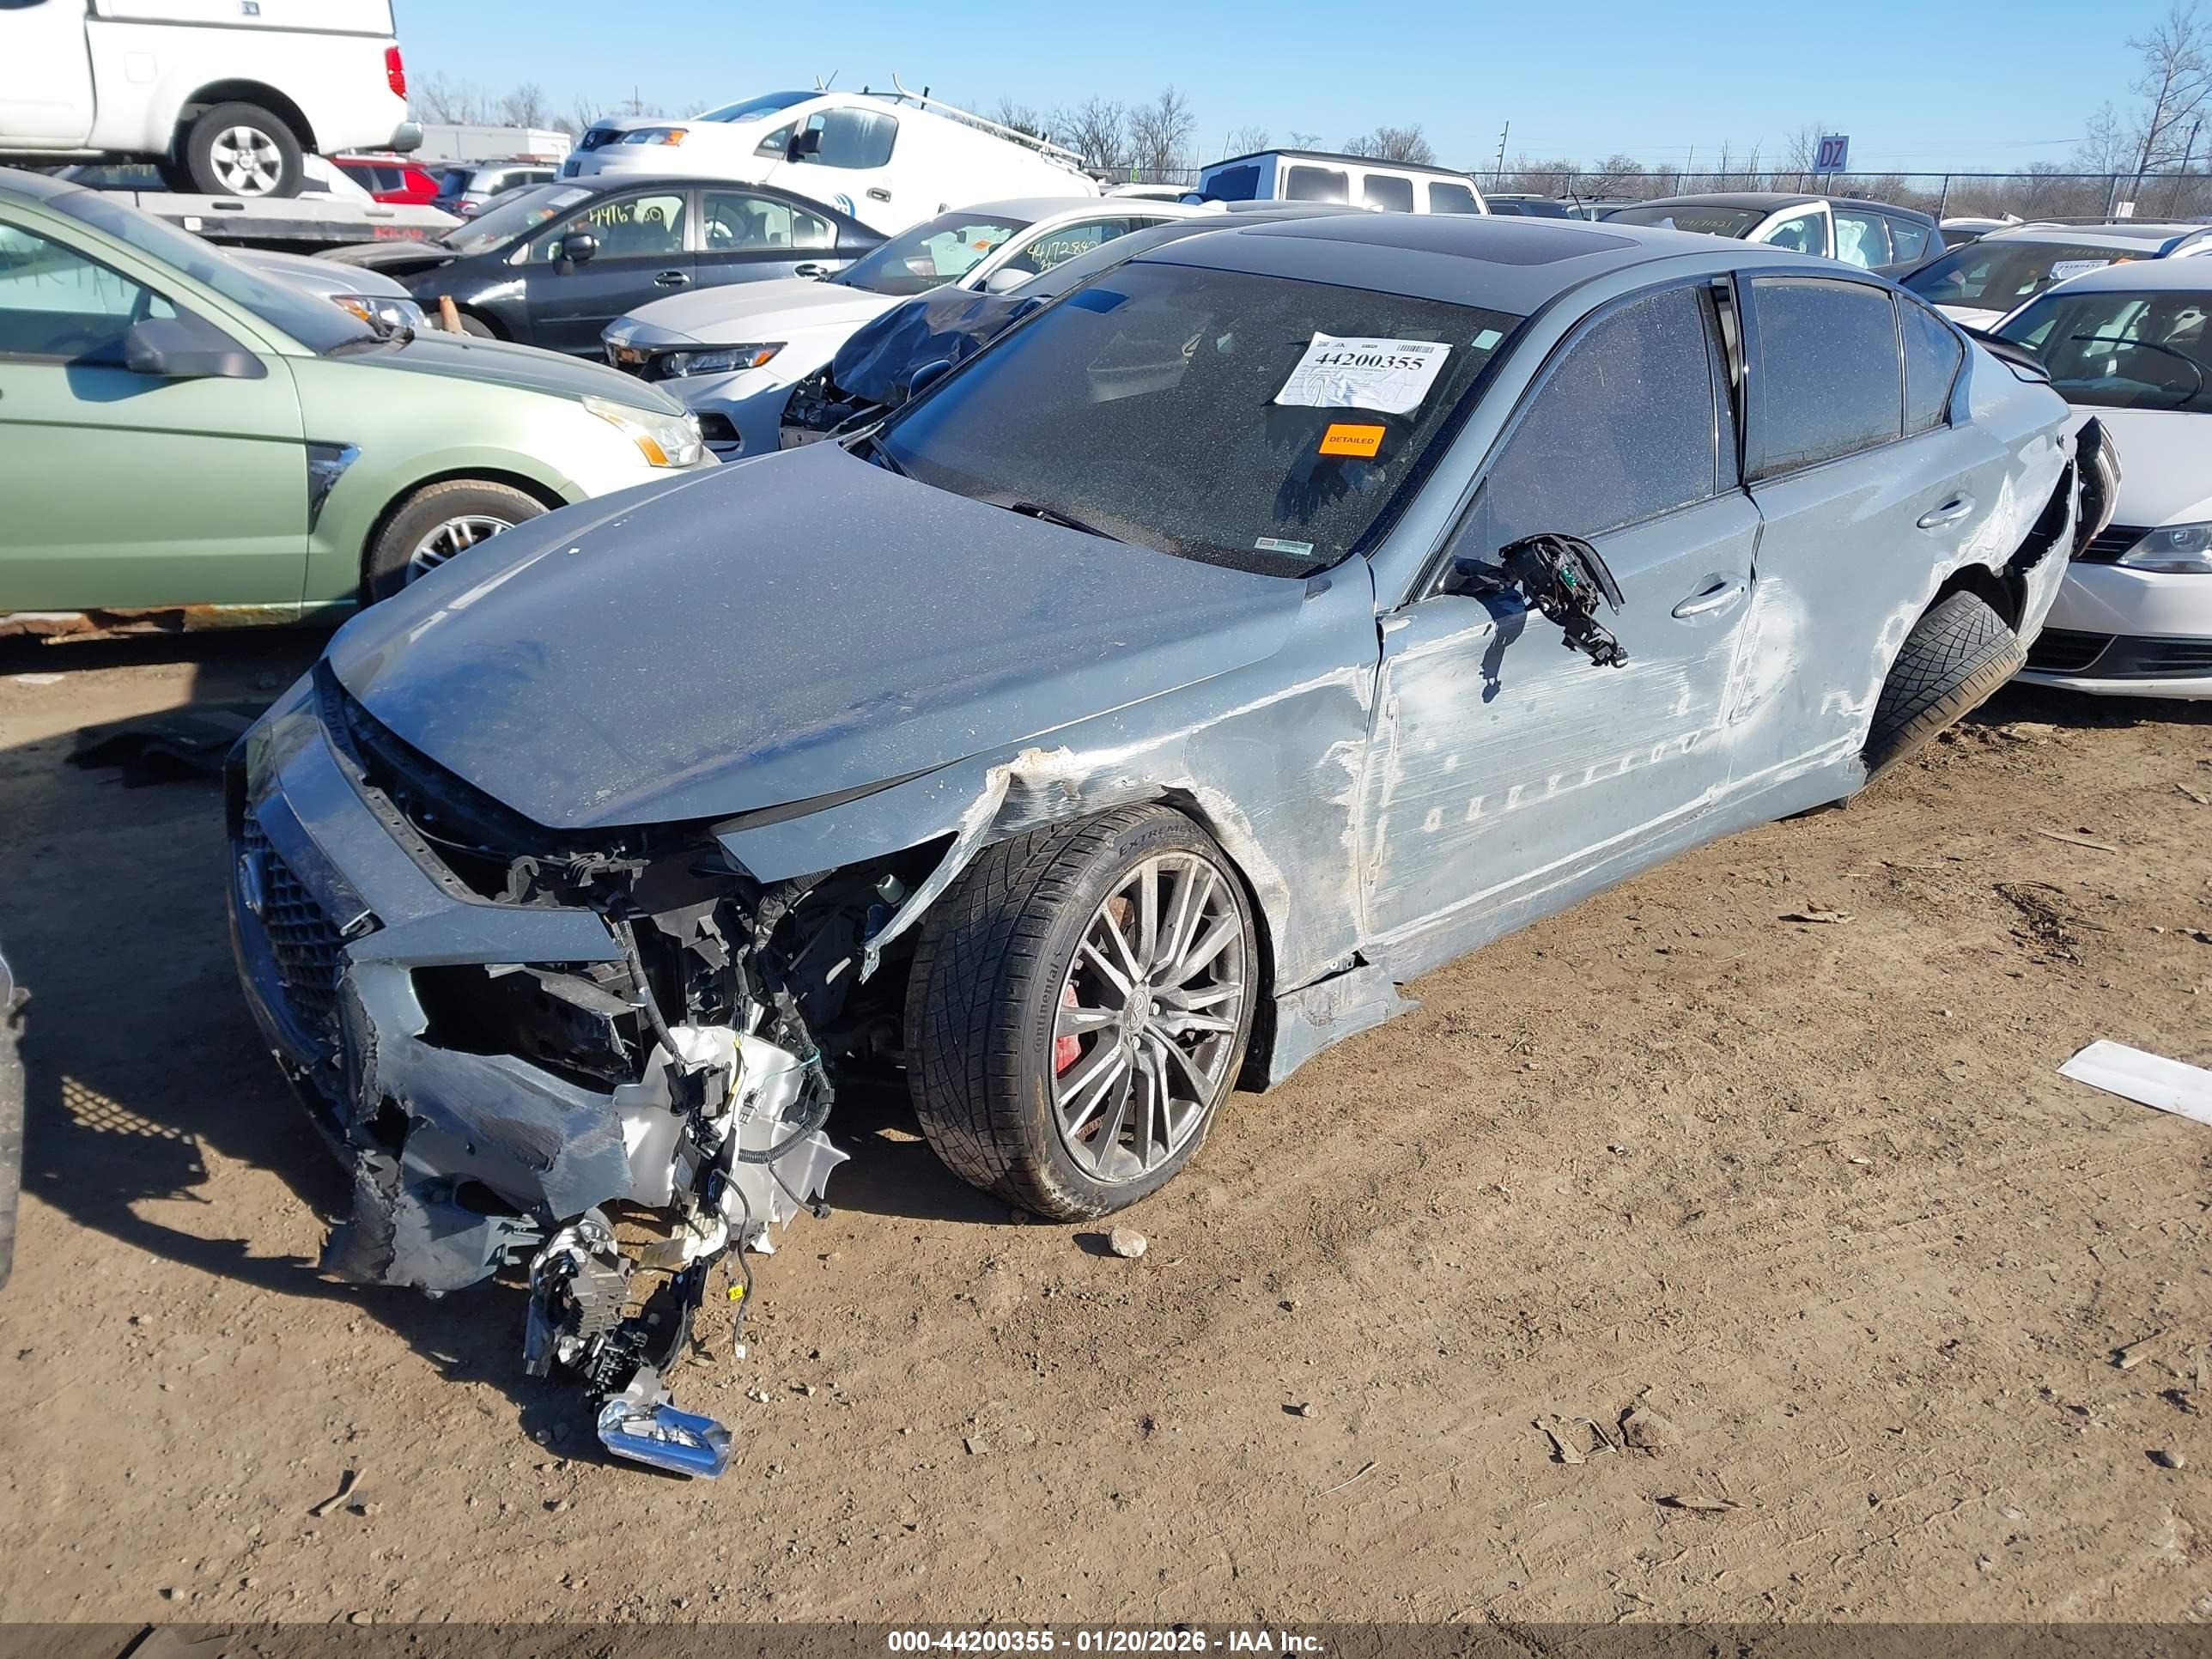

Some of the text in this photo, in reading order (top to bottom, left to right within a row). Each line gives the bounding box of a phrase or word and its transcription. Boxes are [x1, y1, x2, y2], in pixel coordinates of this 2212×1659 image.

[1819, 140, 1844, 167] DZ
[1315, 352, 1425, 371] 44200355
[1329, 436, 1375, 445] DETAILED
[1033, 962, 1060, 1053] Continental
